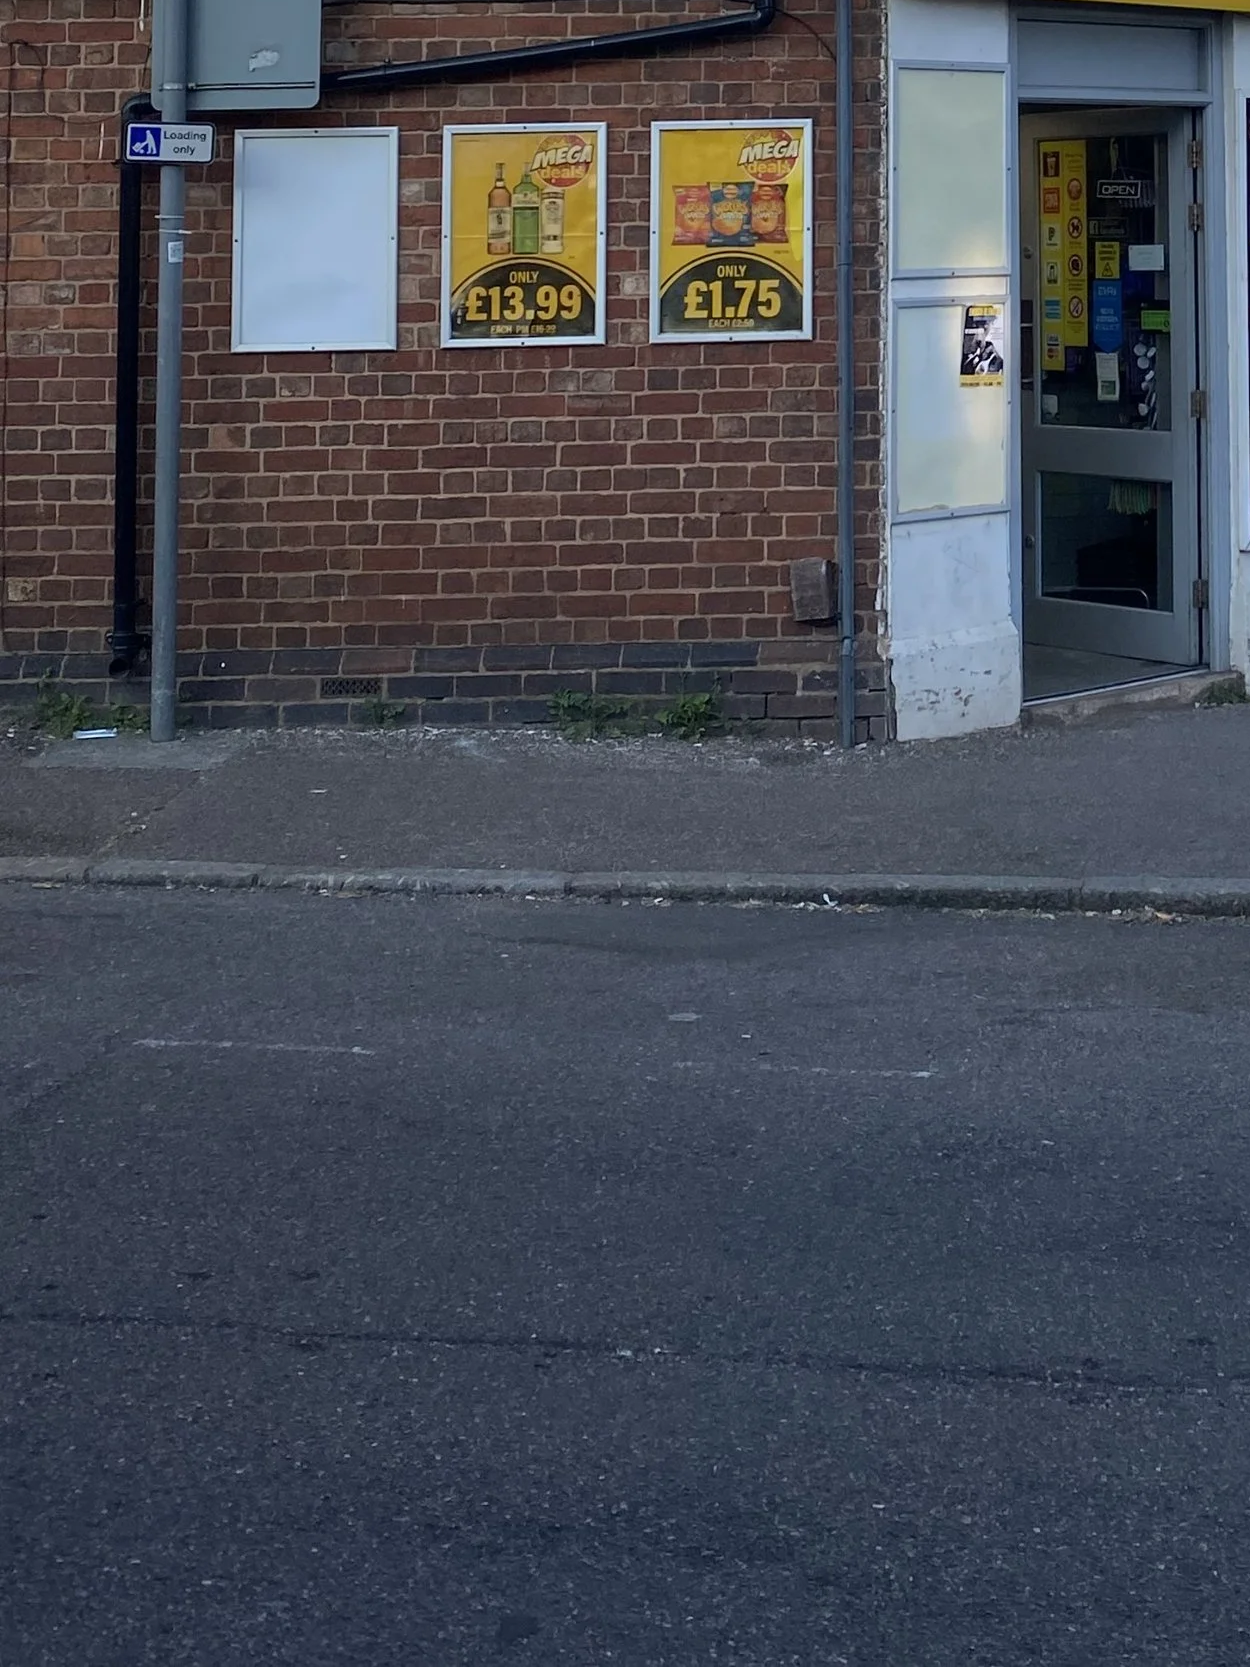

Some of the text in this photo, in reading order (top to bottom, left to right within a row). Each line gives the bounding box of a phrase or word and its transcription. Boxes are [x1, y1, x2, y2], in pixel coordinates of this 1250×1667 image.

[164, 131, 206, 142] Loading
[173, 145, 196, 155] only
[530, 143, 595, 172] MEGA
[737, 139, 801, 166] MEGA
[540, 163, 585, 179] deals
[748, 159, 791, 174] deals
[1101, 185, 1135, 195] OPEN
[509, 270, 539, 283] ONLY
[717, 265, 746, 277] ONLY
[465, 284, 582, 322] £13.99
[684, 279, 781, 319] £1.75
